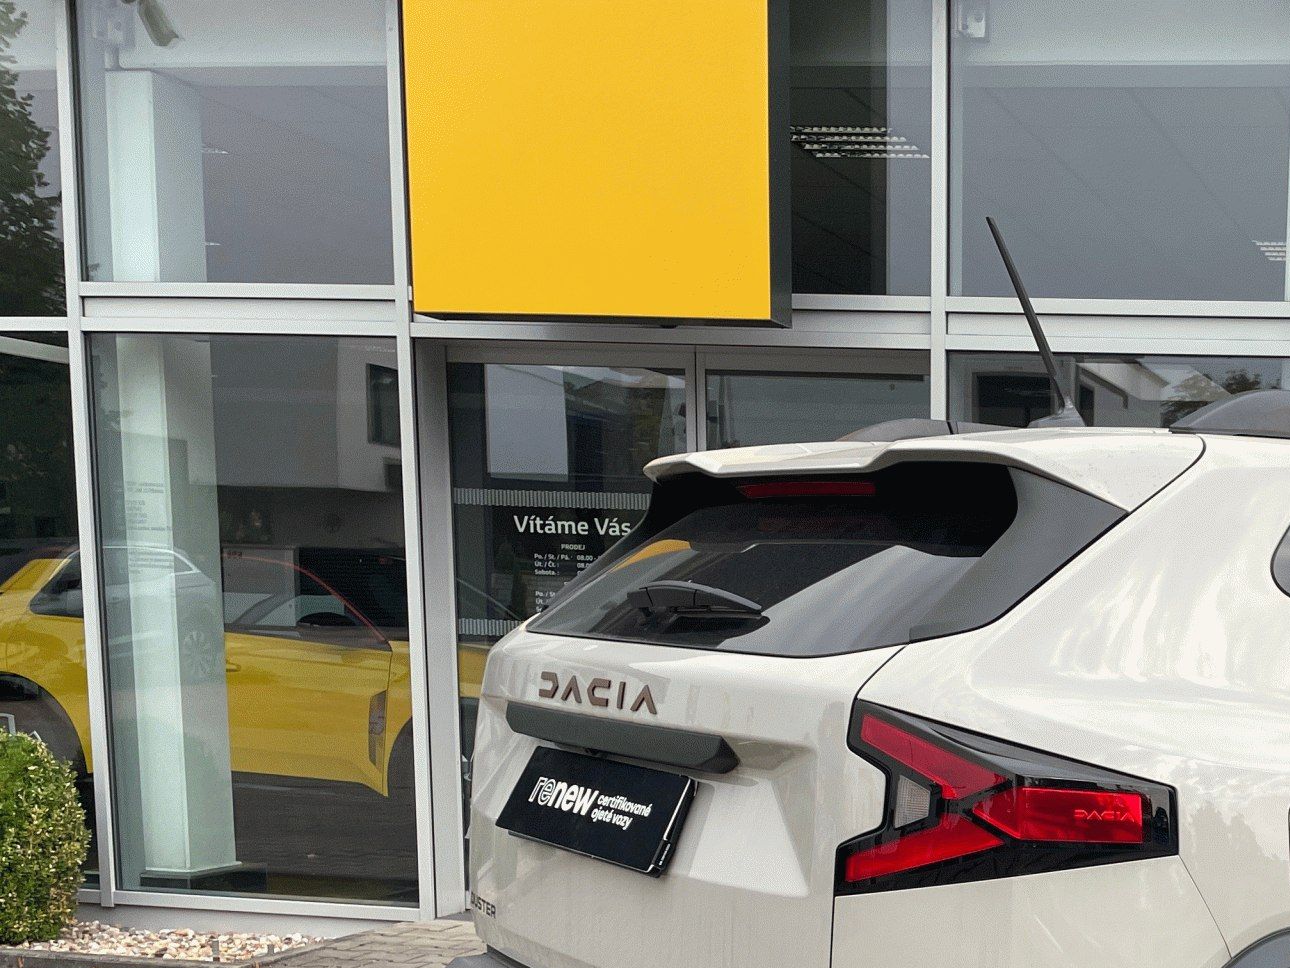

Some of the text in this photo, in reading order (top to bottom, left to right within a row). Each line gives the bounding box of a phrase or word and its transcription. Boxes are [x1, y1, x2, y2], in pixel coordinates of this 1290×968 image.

[513, 514, 631, 536] Vítáme Vás
[538, 671, 658, 715] DACIA
[528, 776, 599, 816] renew
[597, 794, 653, 817] certifikované
[591, 806, 633, 831] ojeté vozy
[1074, 809, 1135, 823] DACIA
